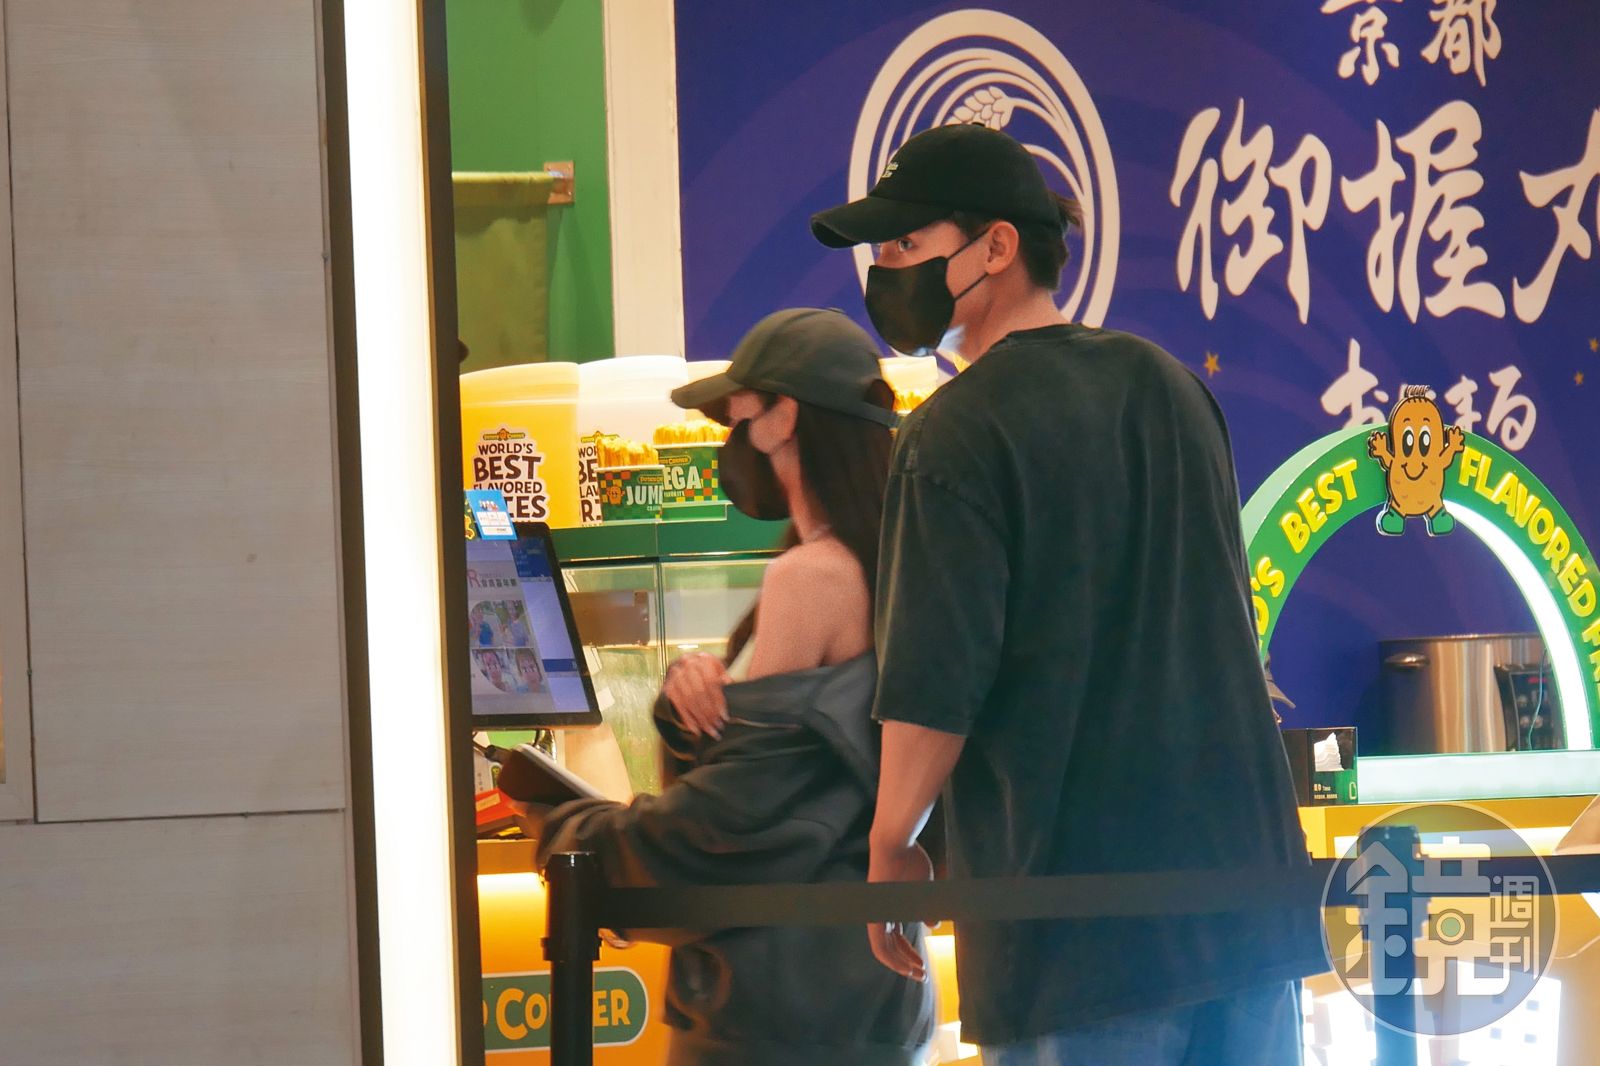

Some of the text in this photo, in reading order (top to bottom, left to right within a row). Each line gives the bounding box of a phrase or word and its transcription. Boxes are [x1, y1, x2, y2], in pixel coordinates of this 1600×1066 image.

[1320, 338, 1537, 451] おまる
[478, 443, 534, 455] WORLD'S
[473, 455, 541, 482] BEST
[663, 466, 702, 491] EGA
[626, 485, 663, 506] JUM
[1281, 459, 1358, 554] BEST
[1458, 446, 1597, 618] FLAVORED
[496, 988, 631, 1040] COER
